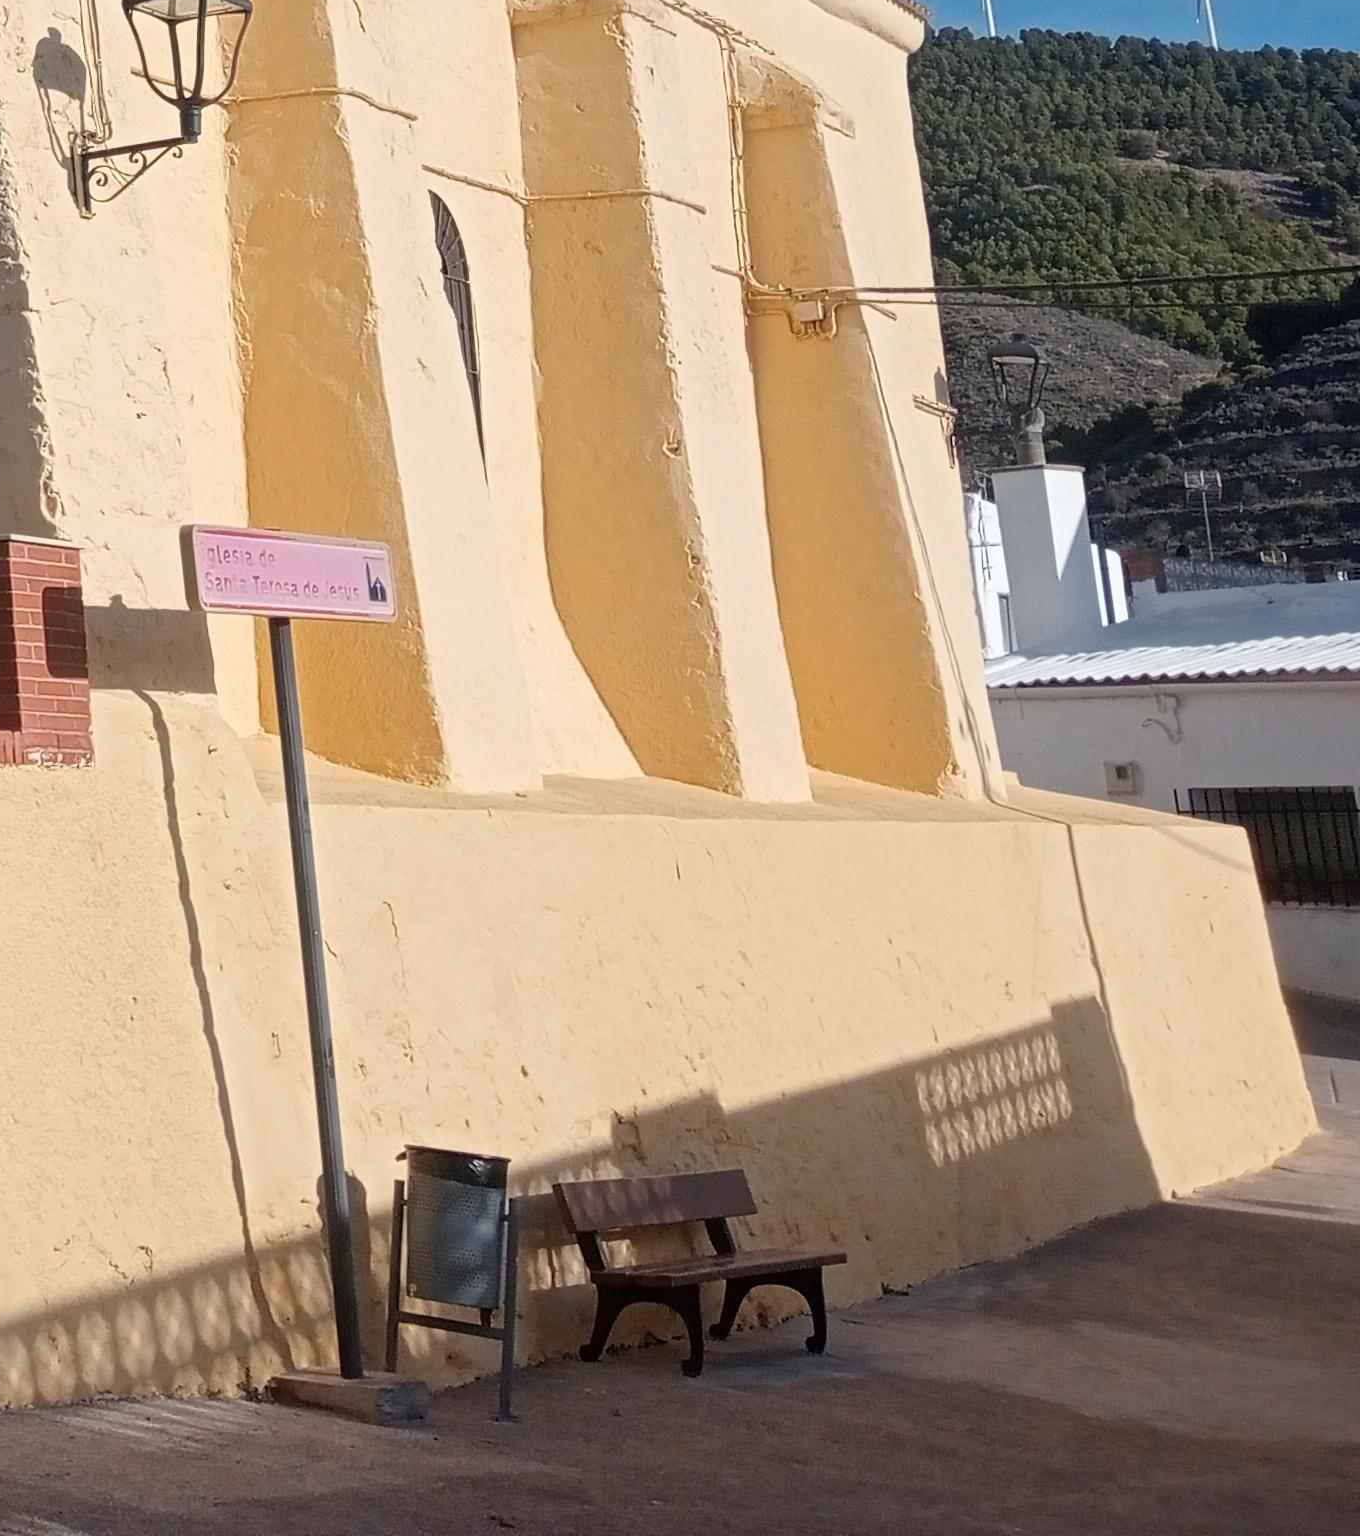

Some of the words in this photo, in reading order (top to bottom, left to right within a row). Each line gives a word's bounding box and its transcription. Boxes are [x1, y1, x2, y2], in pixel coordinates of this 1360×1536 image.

[200, 544, 253, 569] glesia
[259, 549, 276, 568] de
[204, 571, 249, 594] Sana
[252, 575, 299, 597] Teresa
[303, 580, 320, 599] de
